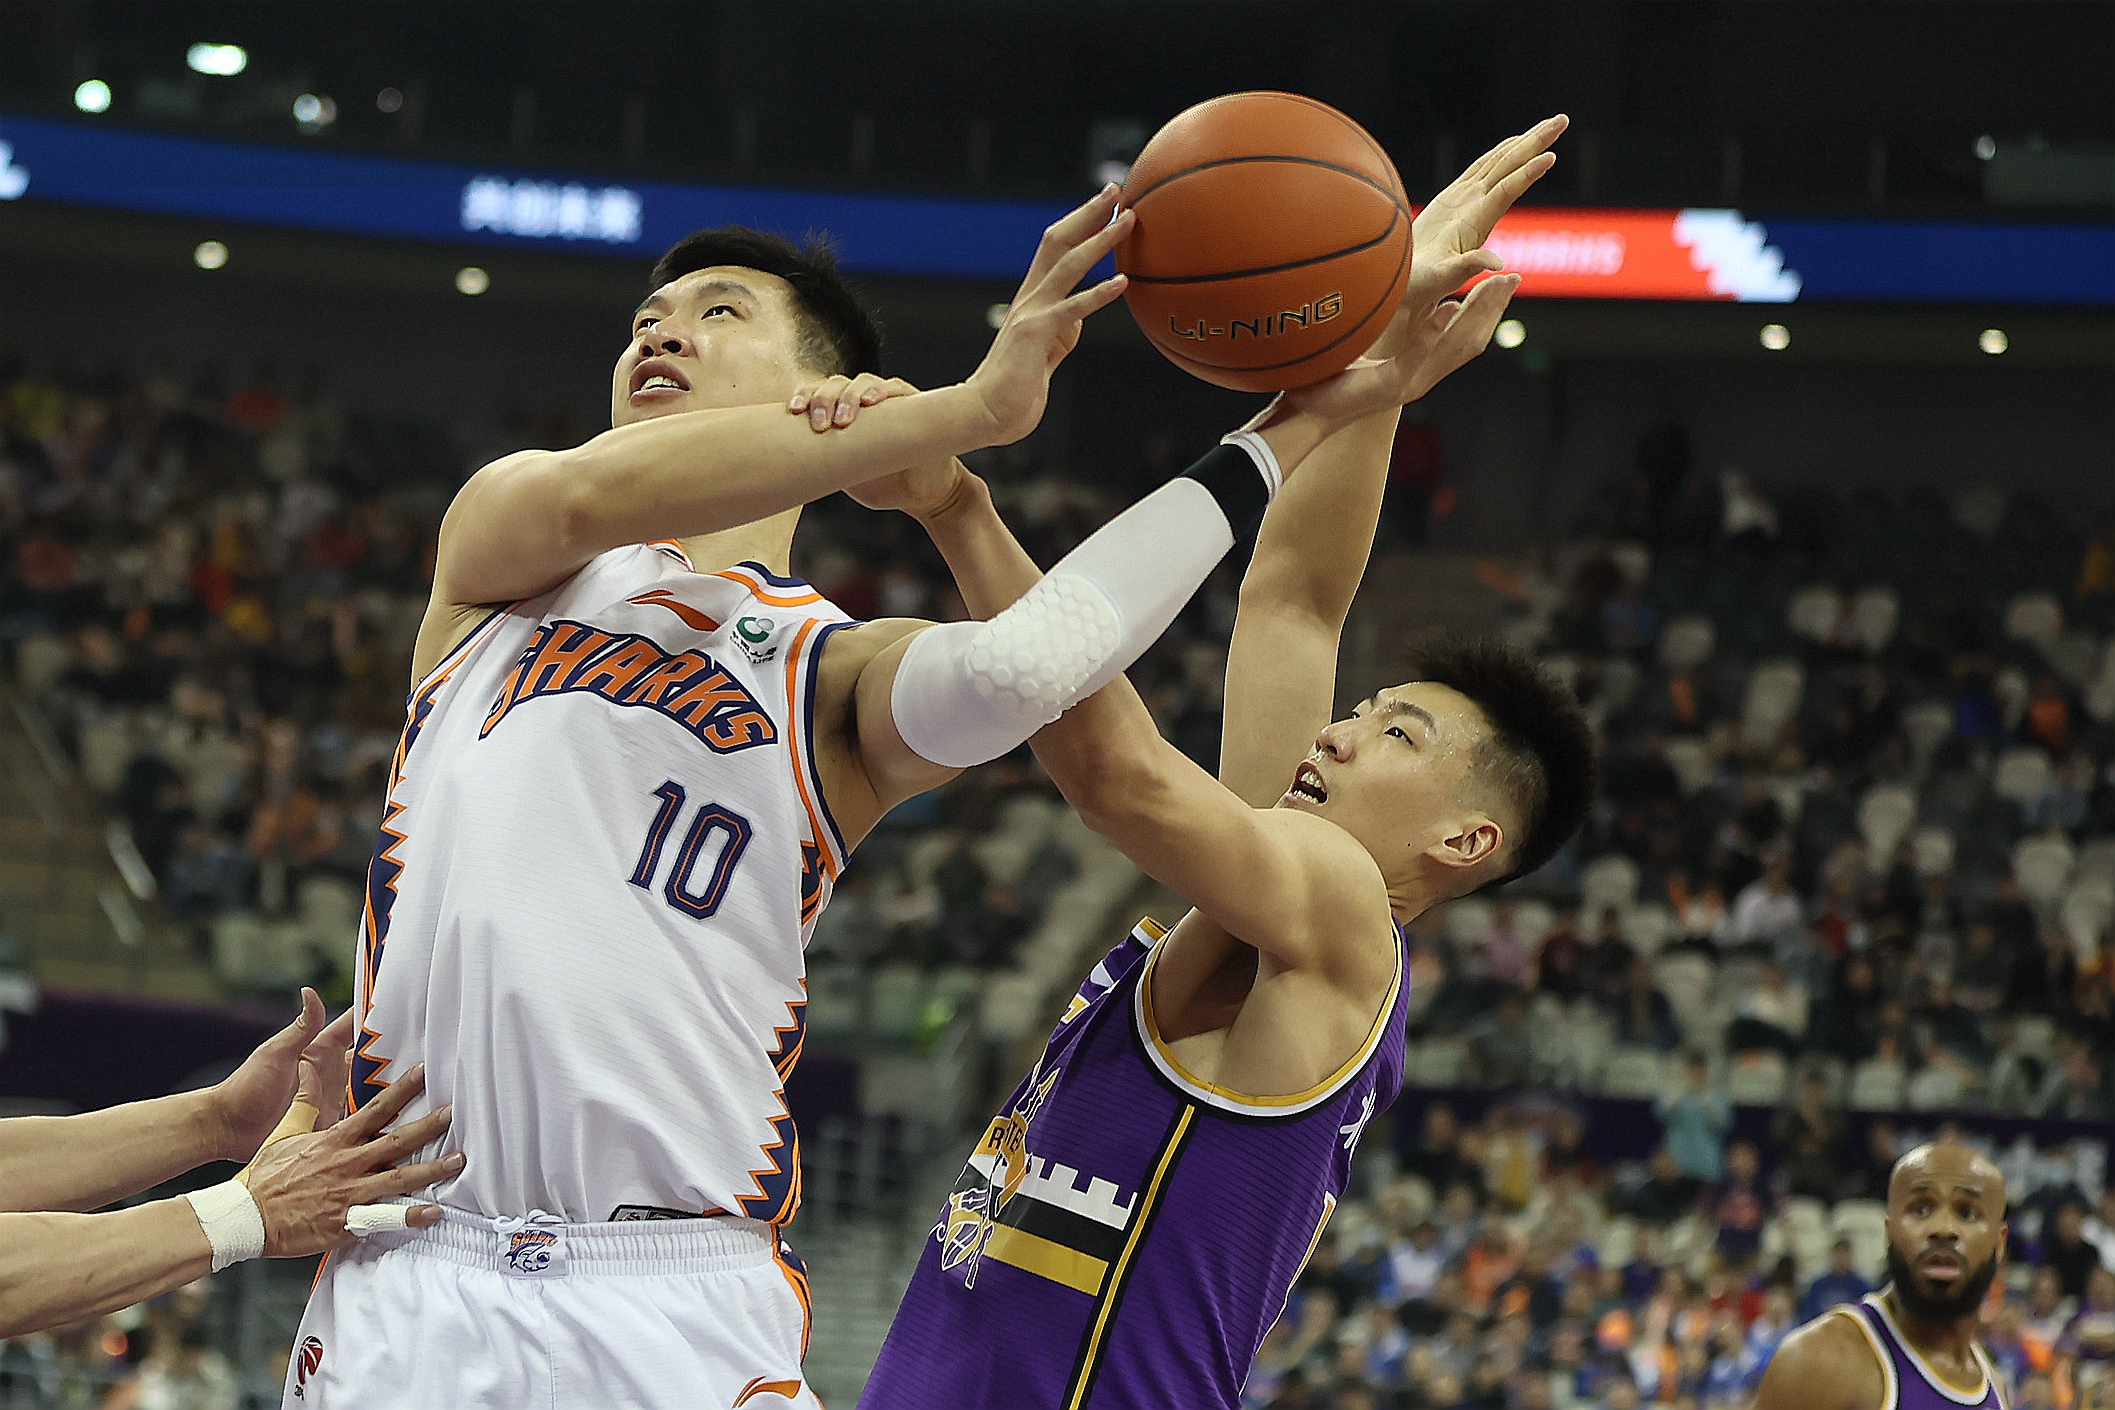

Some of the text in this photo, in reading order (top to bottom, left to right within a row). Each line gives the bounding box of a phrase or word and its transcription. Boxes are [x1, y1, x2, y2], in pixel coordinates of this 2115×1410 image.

[1169, 291, 1344, 341] LI-NING
[477, 619, 779, 755] SHARKS
[627, 779, 754, 921] 10
